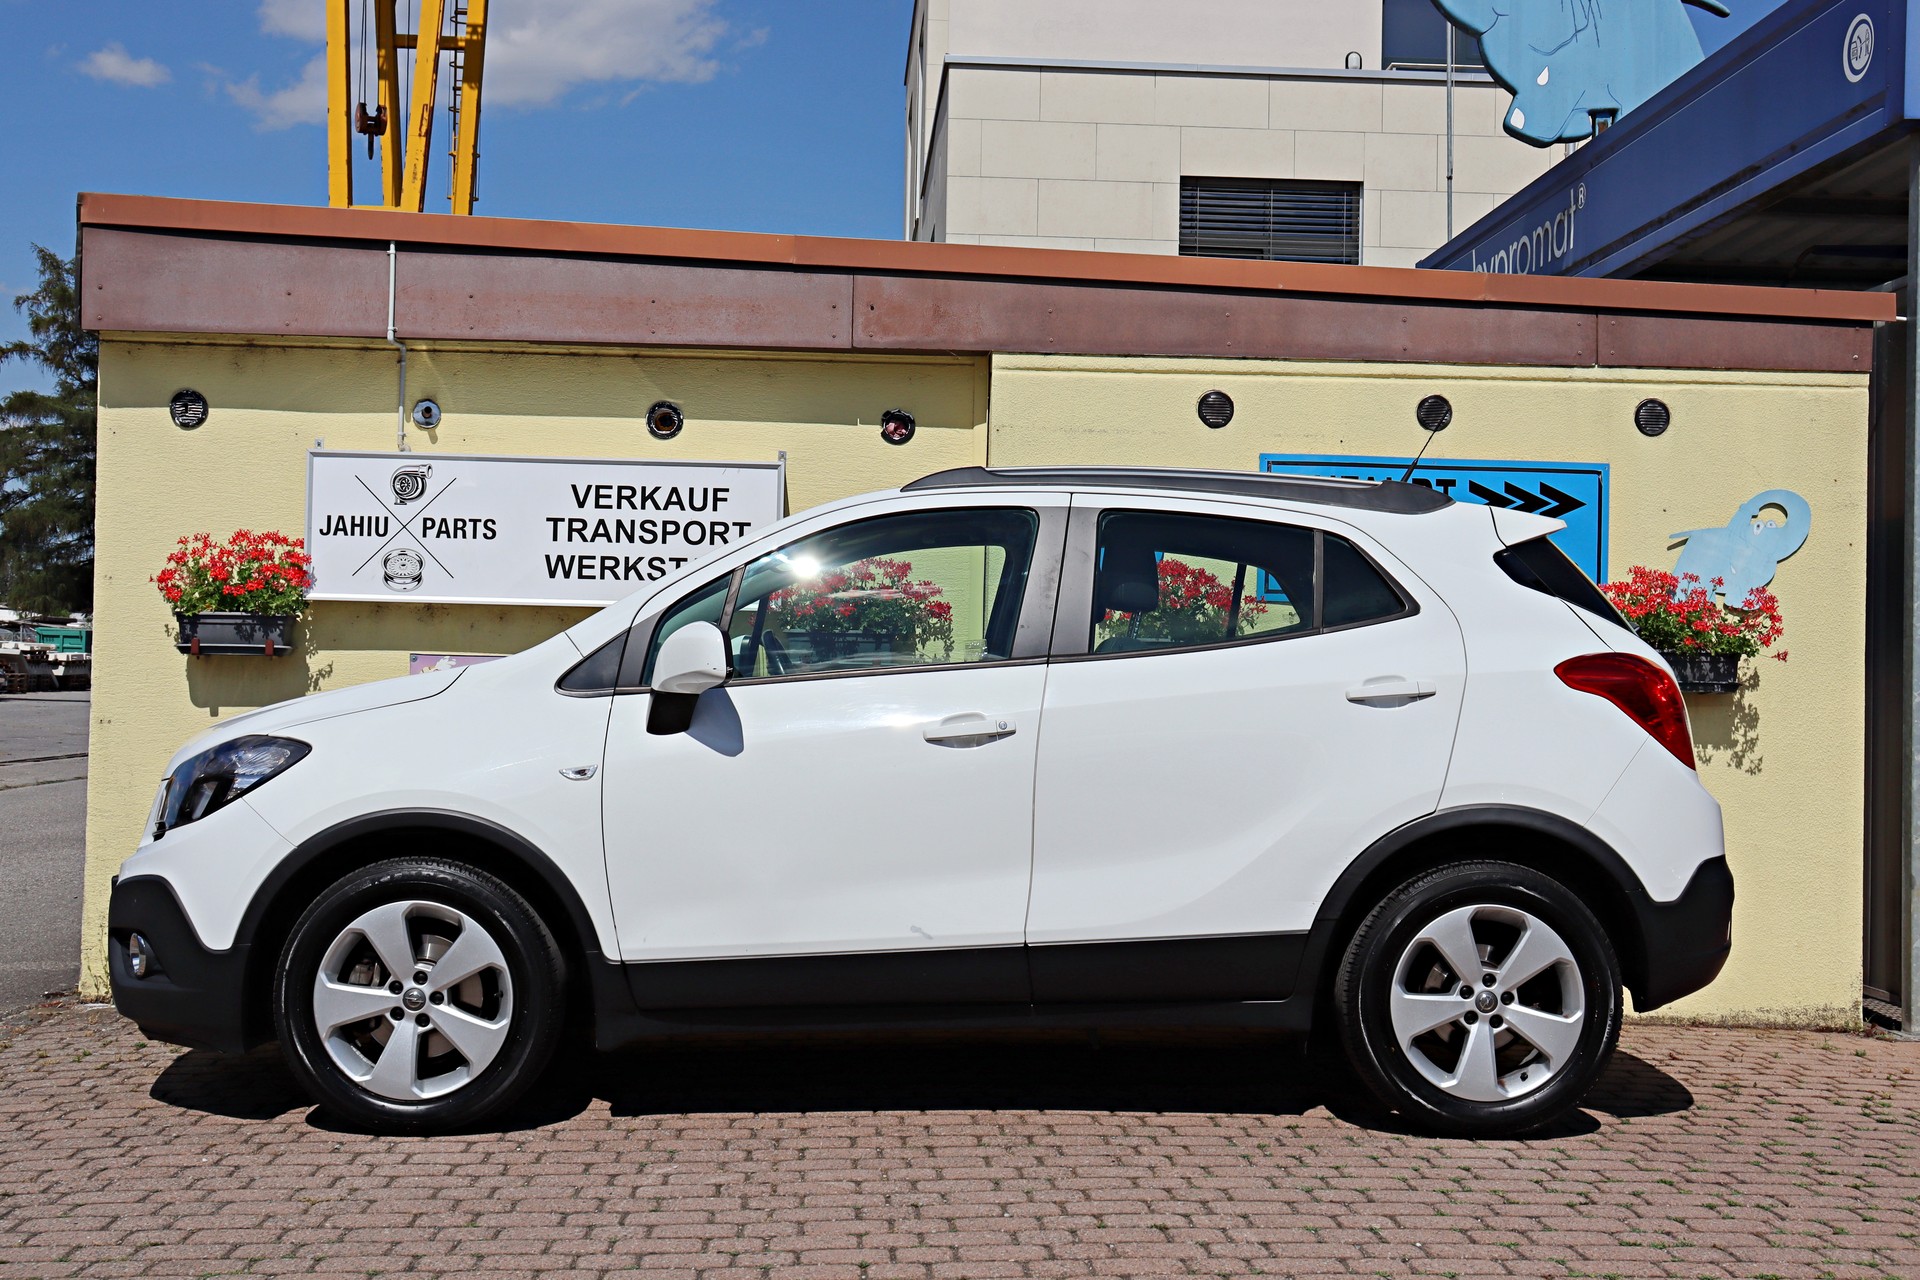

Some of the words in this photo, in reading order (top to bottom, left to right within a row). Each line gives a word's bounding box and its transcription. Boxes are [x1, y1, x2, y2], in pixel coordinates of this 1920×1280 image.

[570, 484, 730, 512] VERKAUF
[319, 514, 389, 538] JAHIU
[422, 517, 497, 540] PARTS
[545, 517, 752, 546] TRANSPORT
[544, 554, 698, 582] WERKST
